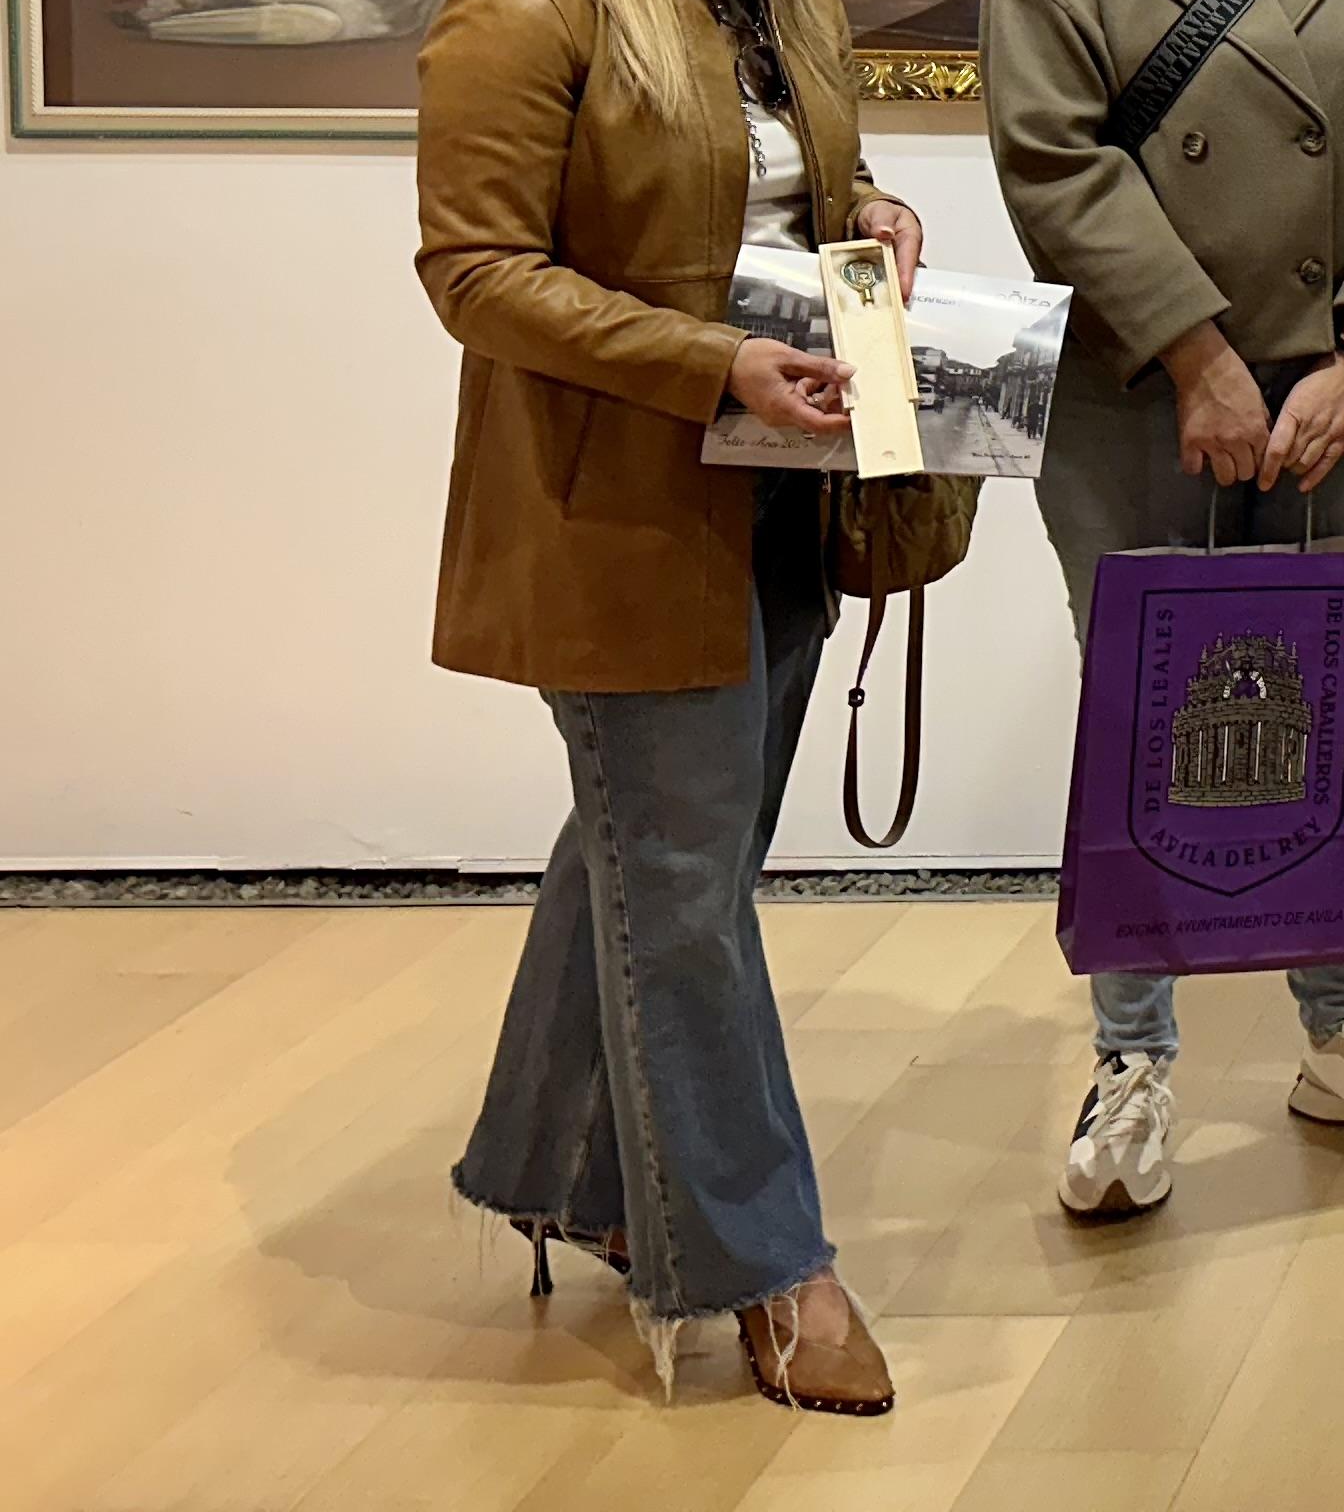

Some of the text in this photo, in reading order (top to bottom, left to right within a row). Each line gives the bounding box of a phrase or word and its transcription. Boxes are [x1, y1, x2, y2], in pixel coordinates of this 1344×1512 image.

[1143, 607, 1177, 815] DE LOS LEALES
[1312, 597, 1344, 808] DE LOS CABALLEROS
[1149, 814, 1324, 869] AVILA DEL REY
[1174, 913, 1283, 937] AYUNTAMIENTO
[1283, 911, 1305, 927] DE
[1305, 908, 1344, 926] AVILA
